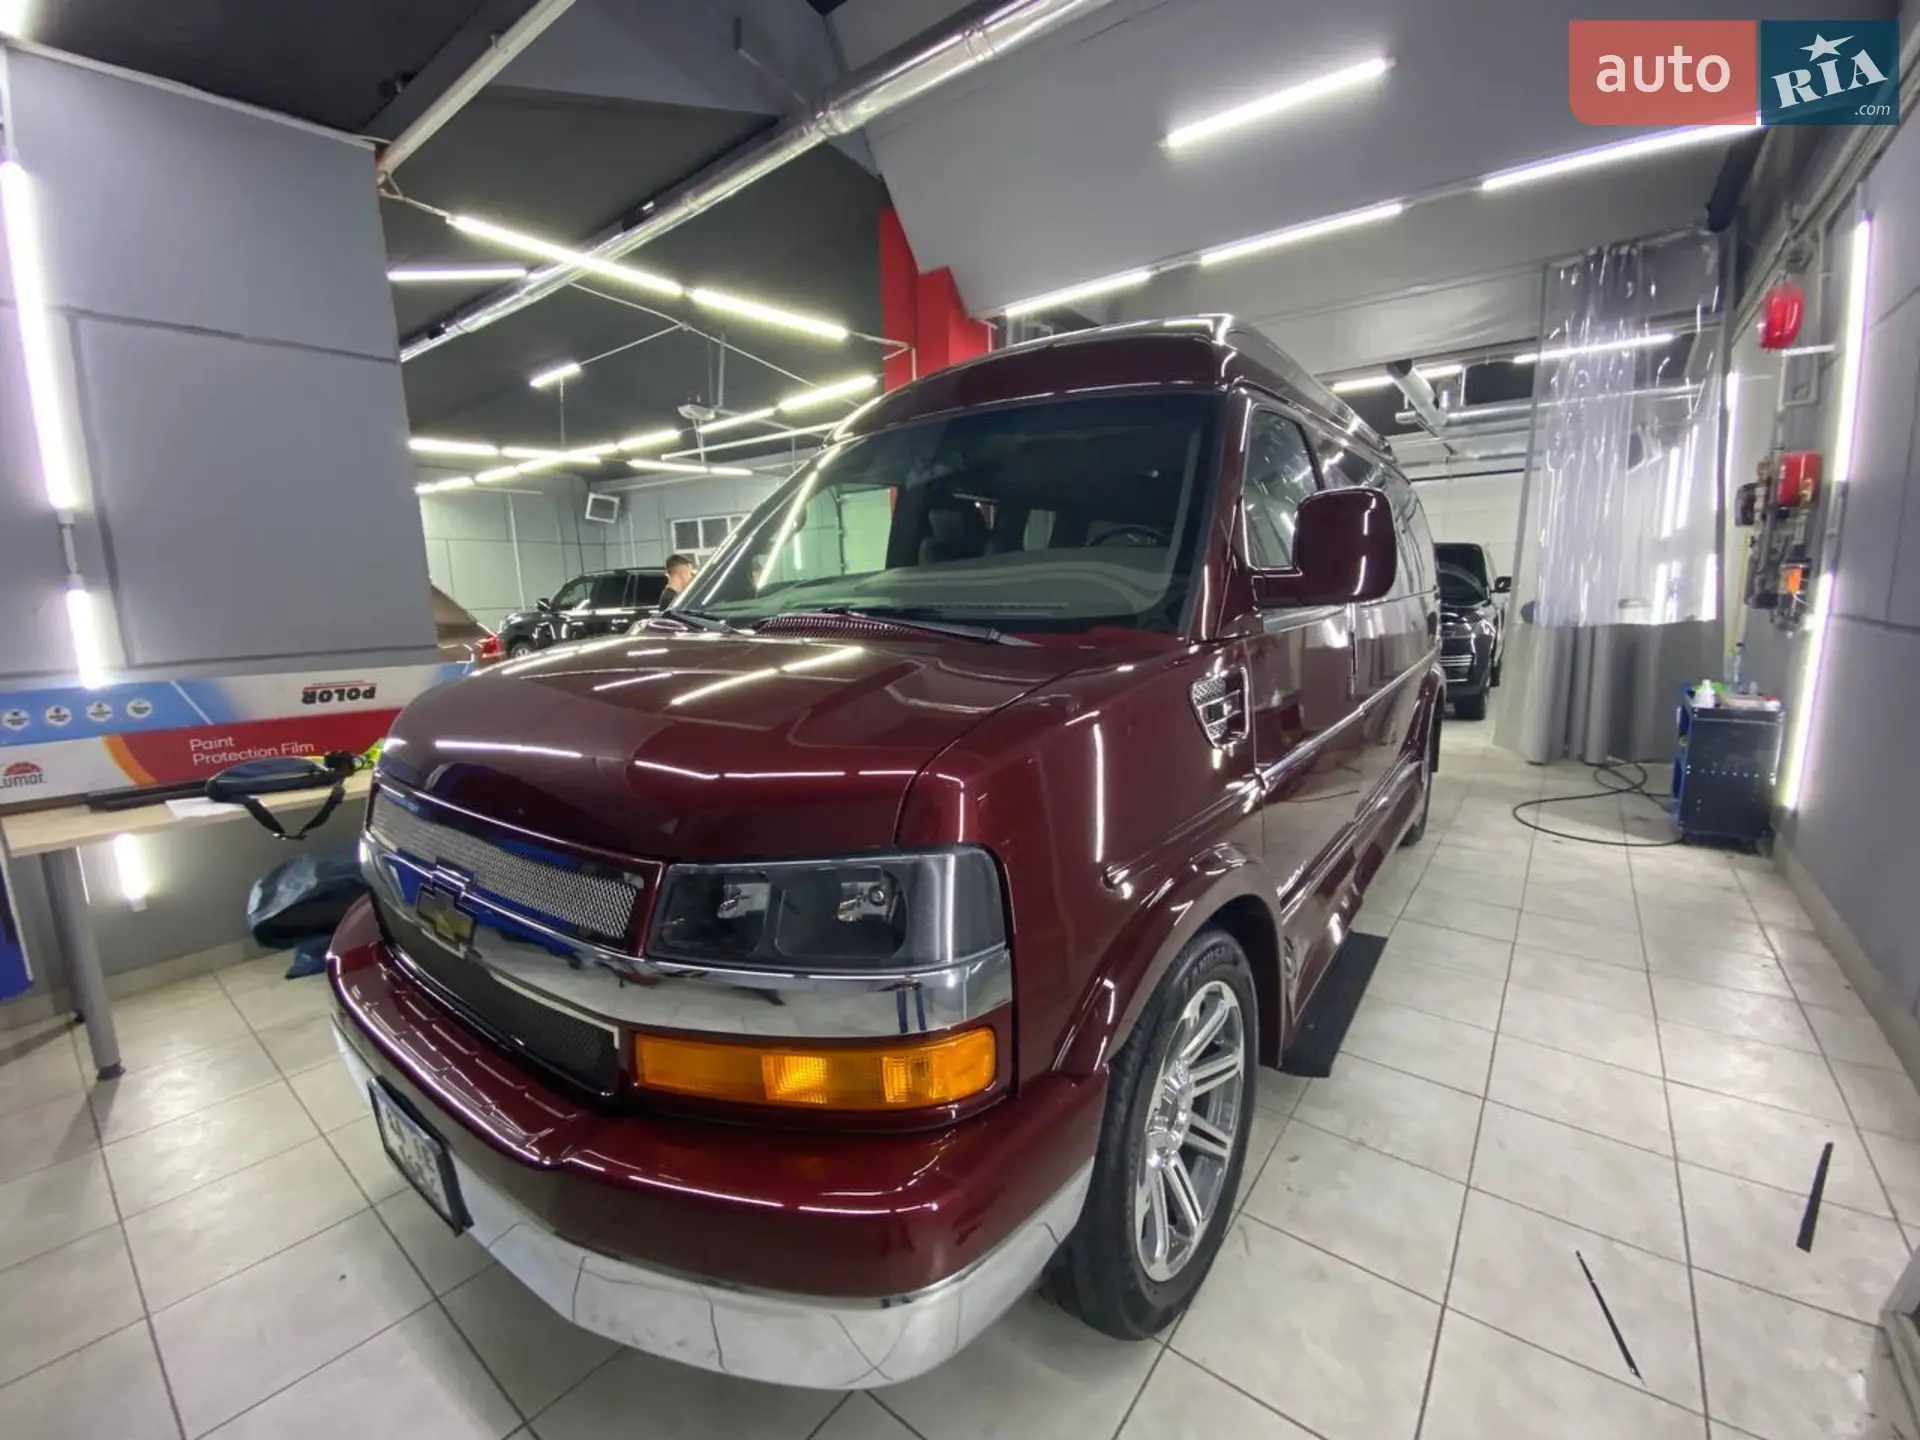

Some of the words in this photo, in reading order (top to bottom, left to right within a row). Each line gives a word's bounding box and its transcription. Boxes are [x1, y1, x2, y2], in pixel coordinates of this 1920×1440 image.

[301, 686, 376, 704] POLOR
[190, 736, 235, 751] Paint
[192, 746, 278, 766] Protection
[281, 741, 315, 755] Film
